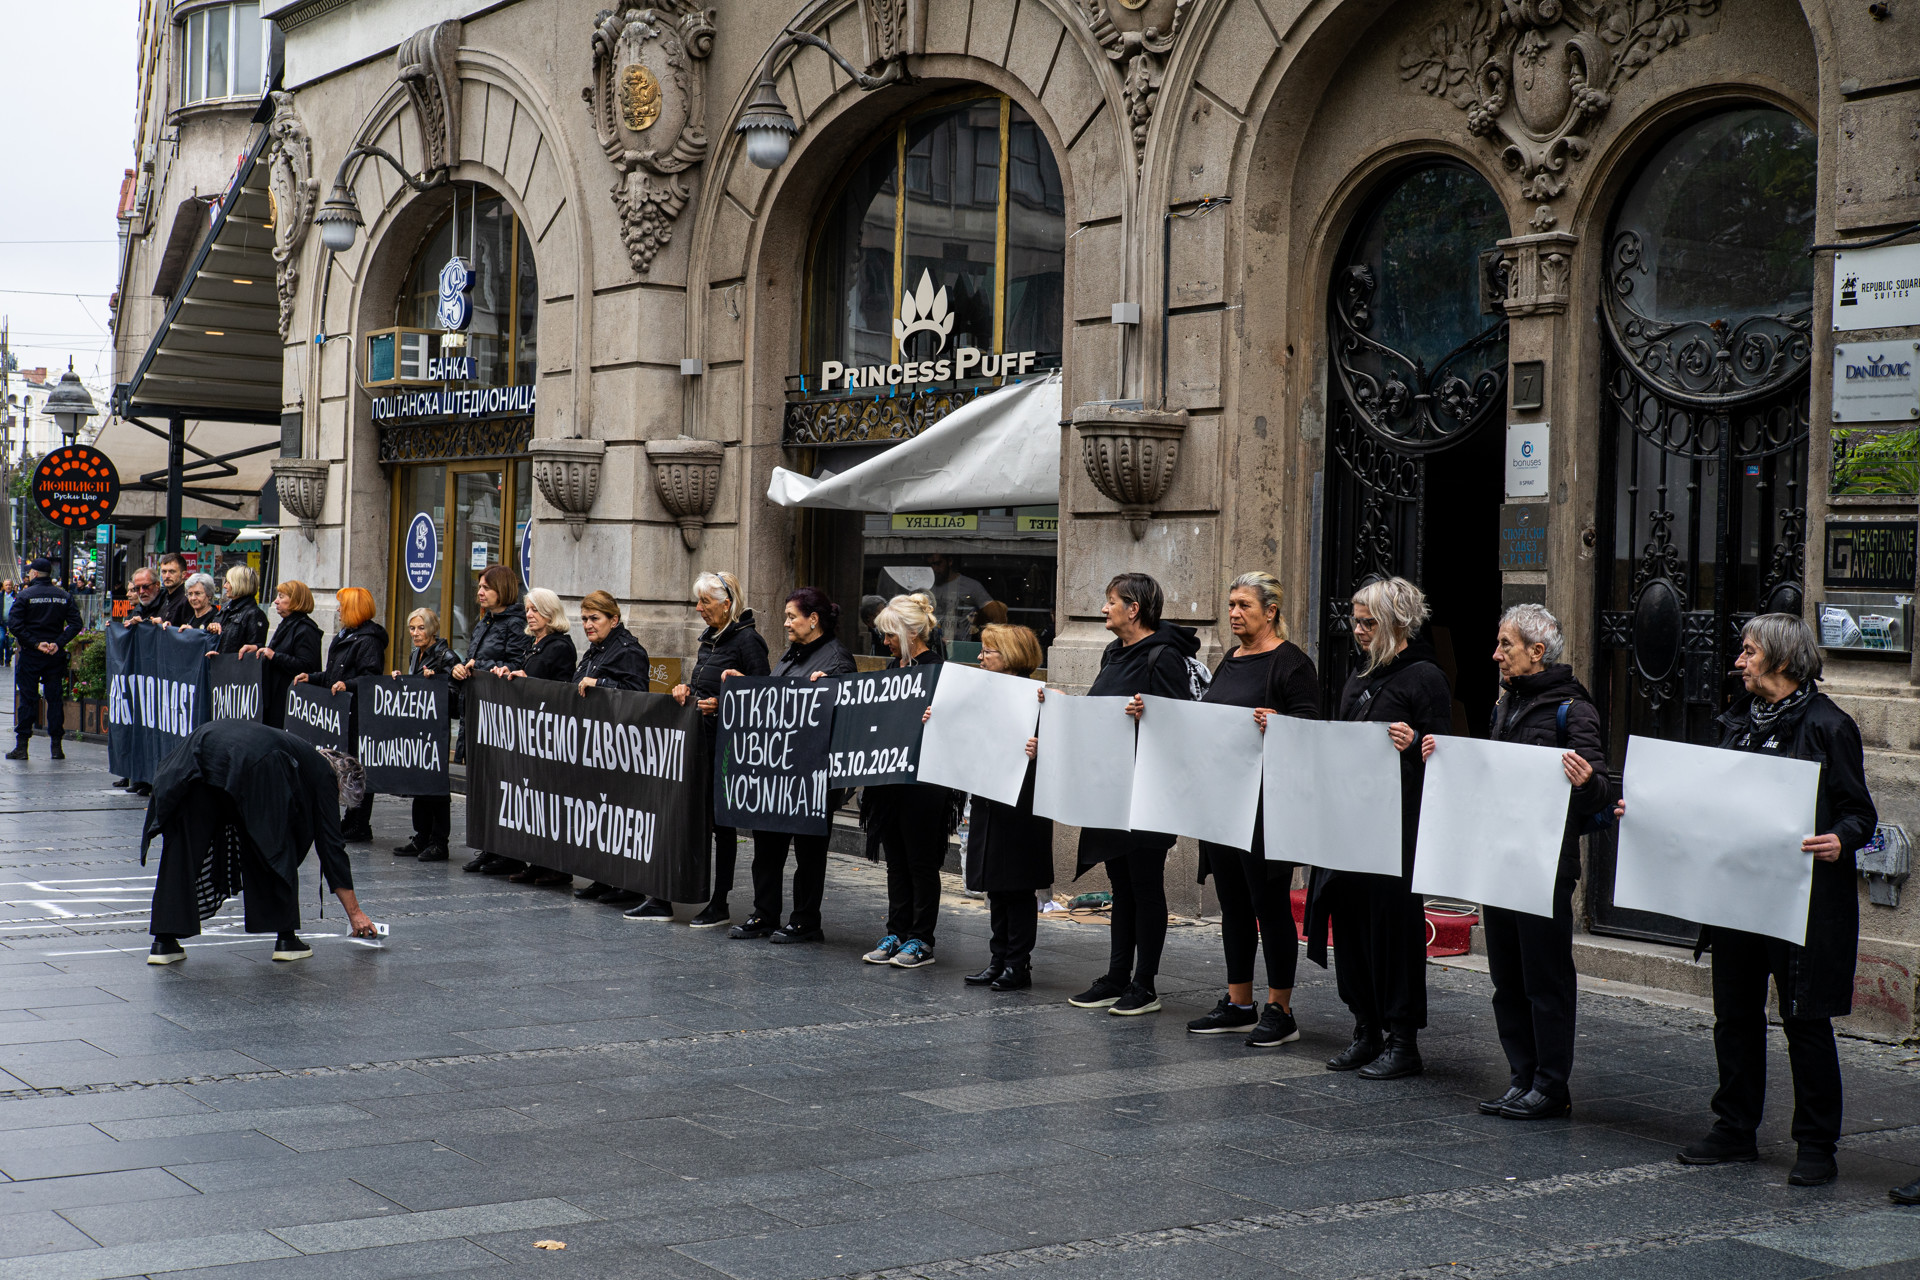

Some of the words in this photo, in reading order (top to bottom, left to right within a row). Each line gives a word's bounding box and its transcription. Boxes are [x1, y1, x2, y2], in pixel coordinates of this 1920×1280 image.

[1861, 280, 1893, 293] REPUBLIC
[1874, 290, 1909, 300] SUITES
[441, 333, 457, 348] 1921
[428, 356, 469, 381] БАНКА
[821, 359, 951, 391] PRINCESS
[955, 347, 1036, 380] PUFF
[1522, 375, 1534, 401] 7
[372, 391, 440, 419] ПОШТАНСКА
[442, 384, 536, 418] ШТЕДИОНИЦА
[1513, 459, 1541, 467] bonuses
[39, 480, 111, 493] MONUMENT
[1502, 527, 1545, 540] СПОРТСКИ
[1509, 540, 1537, 552] САВЕЗ
[1852, 529, 1914, 551] NEKRETNINE
[1502, 552, 1544, 565] СРБИЈЕ
[213, 682, 259, 721] PAMTIMO
[287, 690, 341, 736] DRAGANA
[374, 684, 437, 720] DRAŽENA
[722, 680, 829, 730] OTKRIJTE
[477, 699, 515, 751] NIKAD
[517, 702, 578, 765] NEĆEMO
[582, 718, 686, 782] ZABORAVITI
[733, 730, 798, 770] UBICE
[498, 778, 546, 838] ZLOČIN
[549, 793, 560, 842] U
[563, 793, 656, 864] TOPČIDERU
